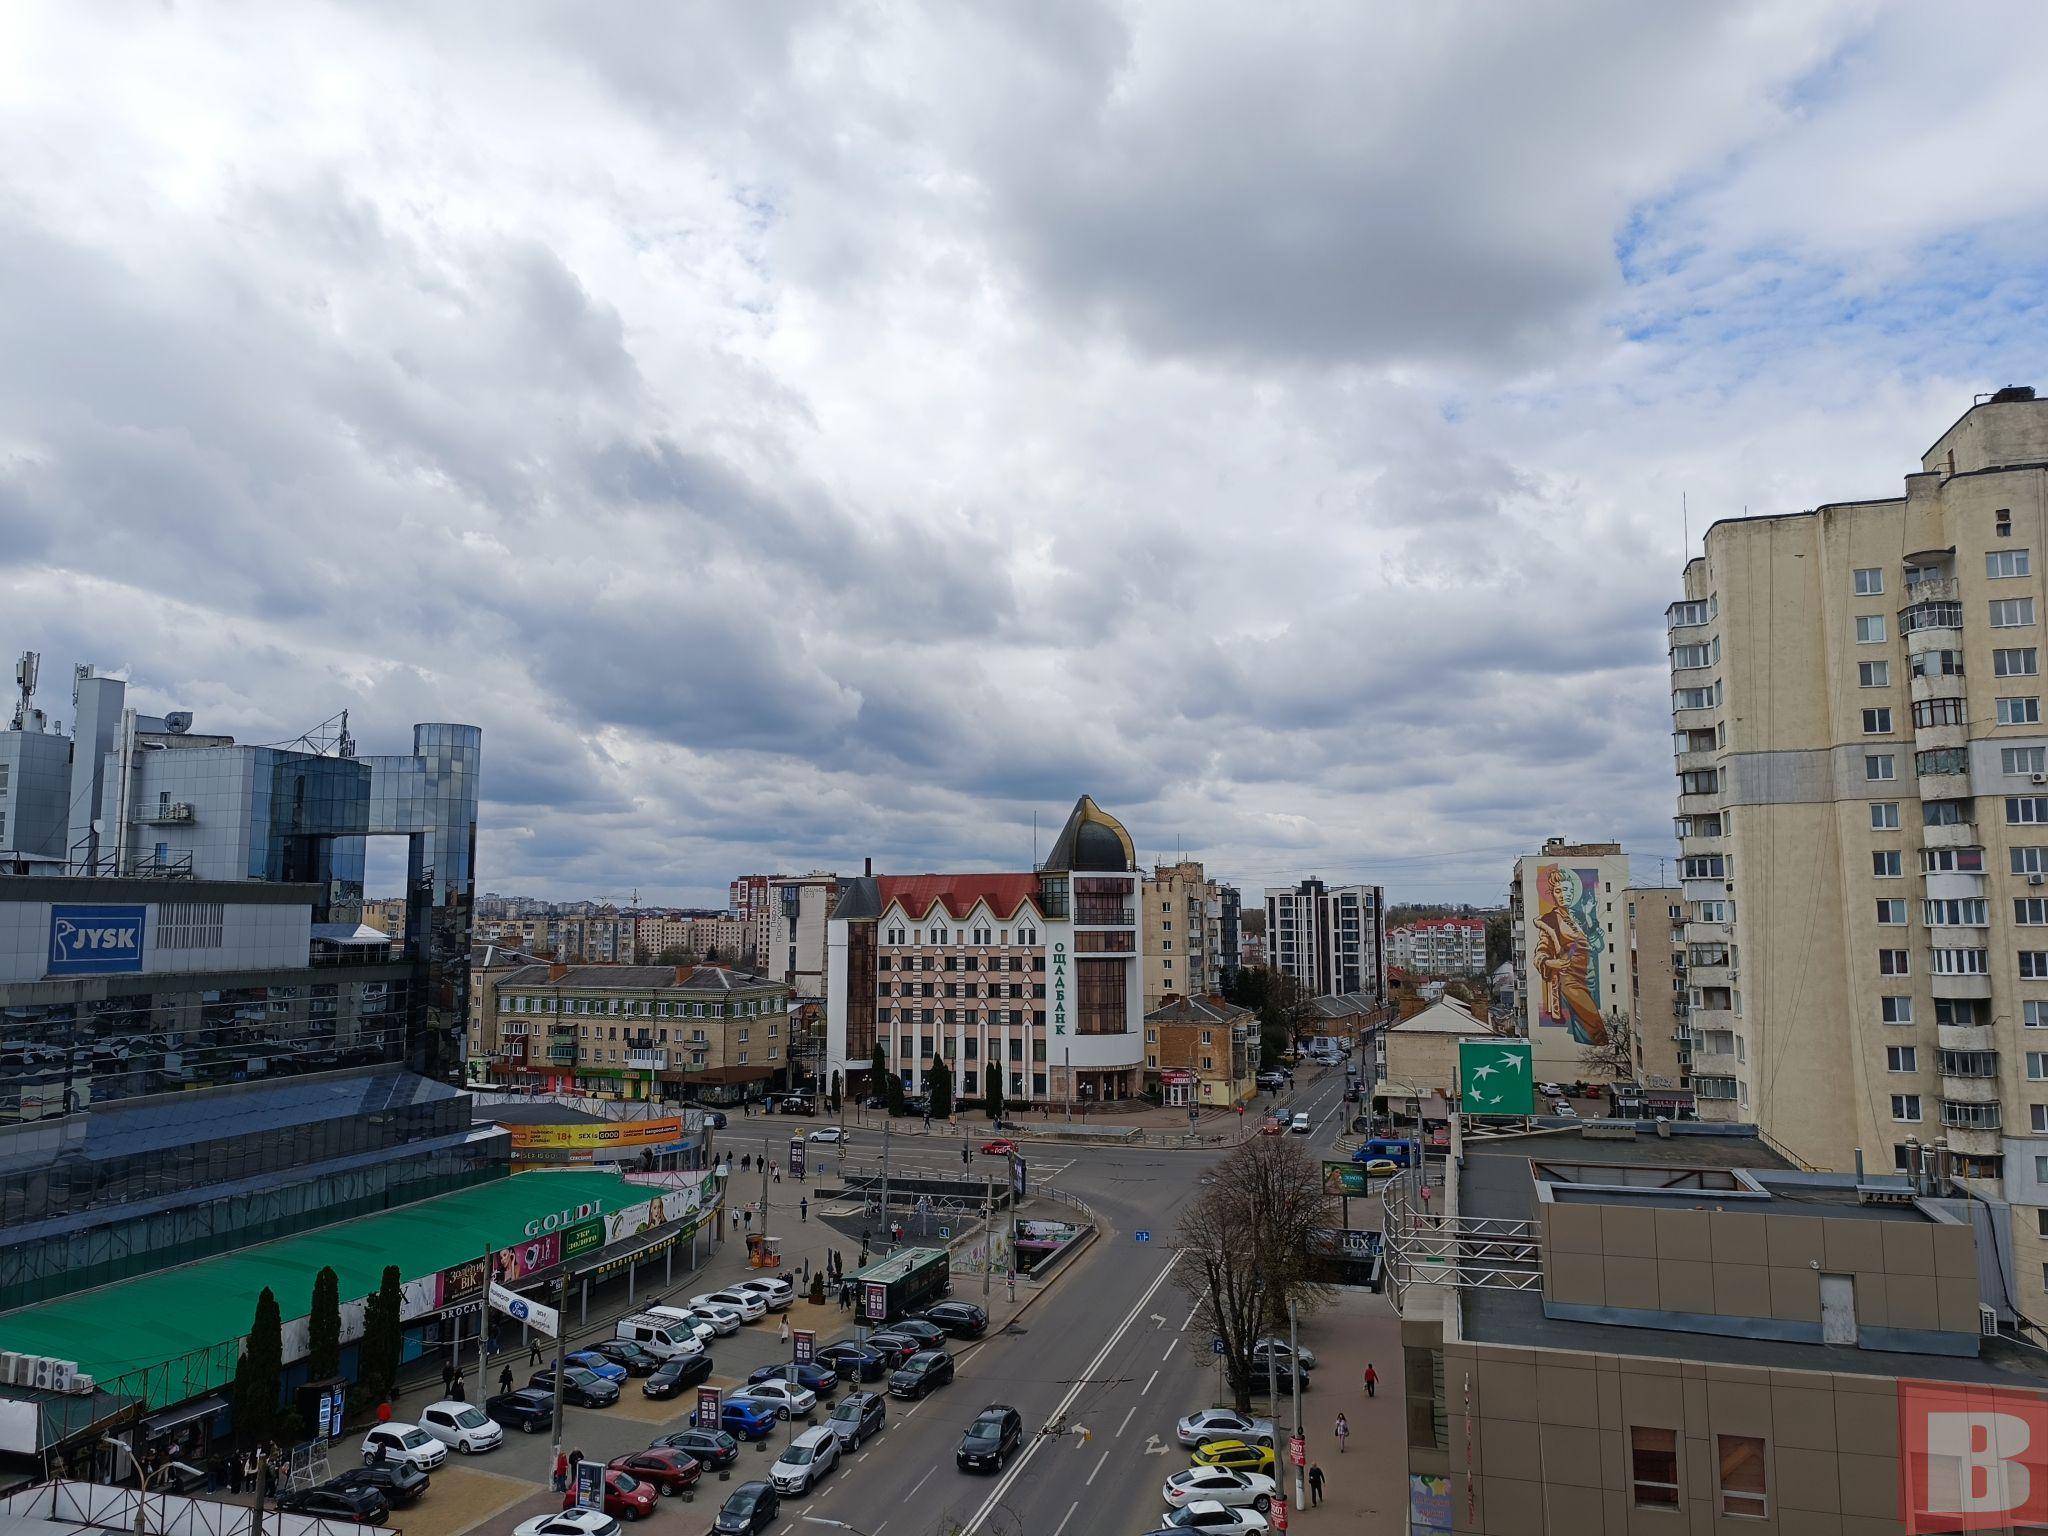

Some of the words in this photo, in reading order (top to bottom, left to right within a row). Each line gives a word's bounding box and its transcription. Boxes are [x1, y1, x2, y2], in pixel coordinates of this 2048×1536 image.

[73, 928, 136, 949] JYSK
[1053, 943, 1066, 1034] ОЩАДБАНК
[556, 1132, 572, 1140] 18+
[524, 1200, 602, 1237] GOLDI
[568, 1235, 597, 1250] ЗОЛОТО
[576, 1230, 590, 1239] УКР
[1342, 1238, 1369, 1249] LUX
[441, 1302, 485, 1320] BROCAR
